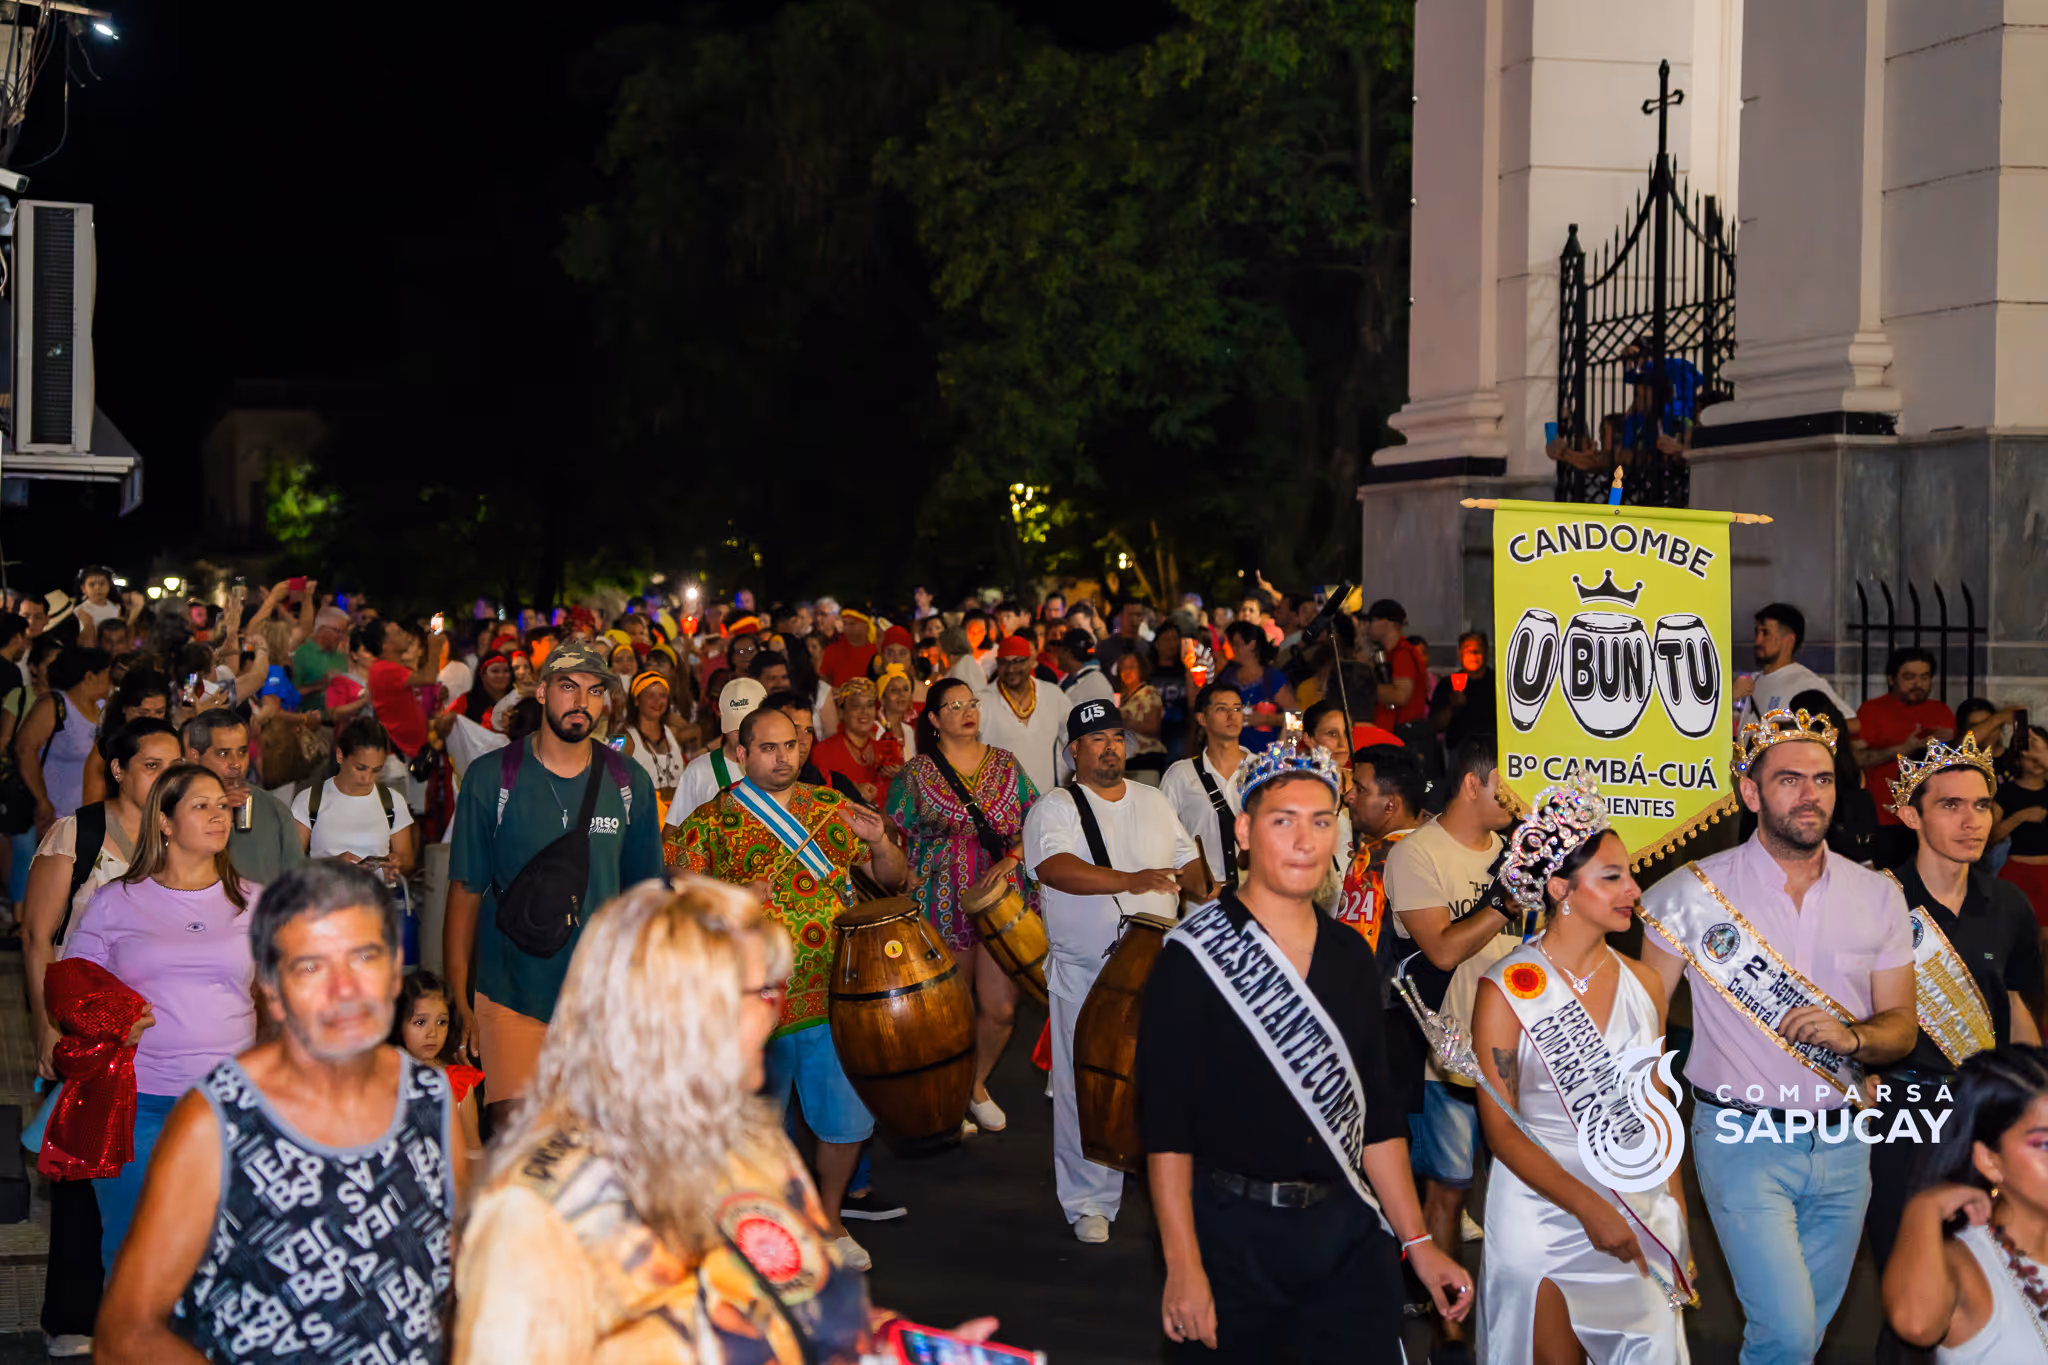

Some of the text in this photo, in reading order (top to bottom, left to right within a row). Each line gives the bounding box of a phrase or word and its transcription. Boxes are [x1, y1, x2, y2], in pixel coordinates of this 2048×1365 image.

[1509, 523, 1714, 578] CANDOMBE
[1543, 753, 1717, 789] CAMBÁ-CUÁ
[1727, 977, 1779, 1026] Carnaval
[1530, 1015, 1589, 1096] COMPARSA
